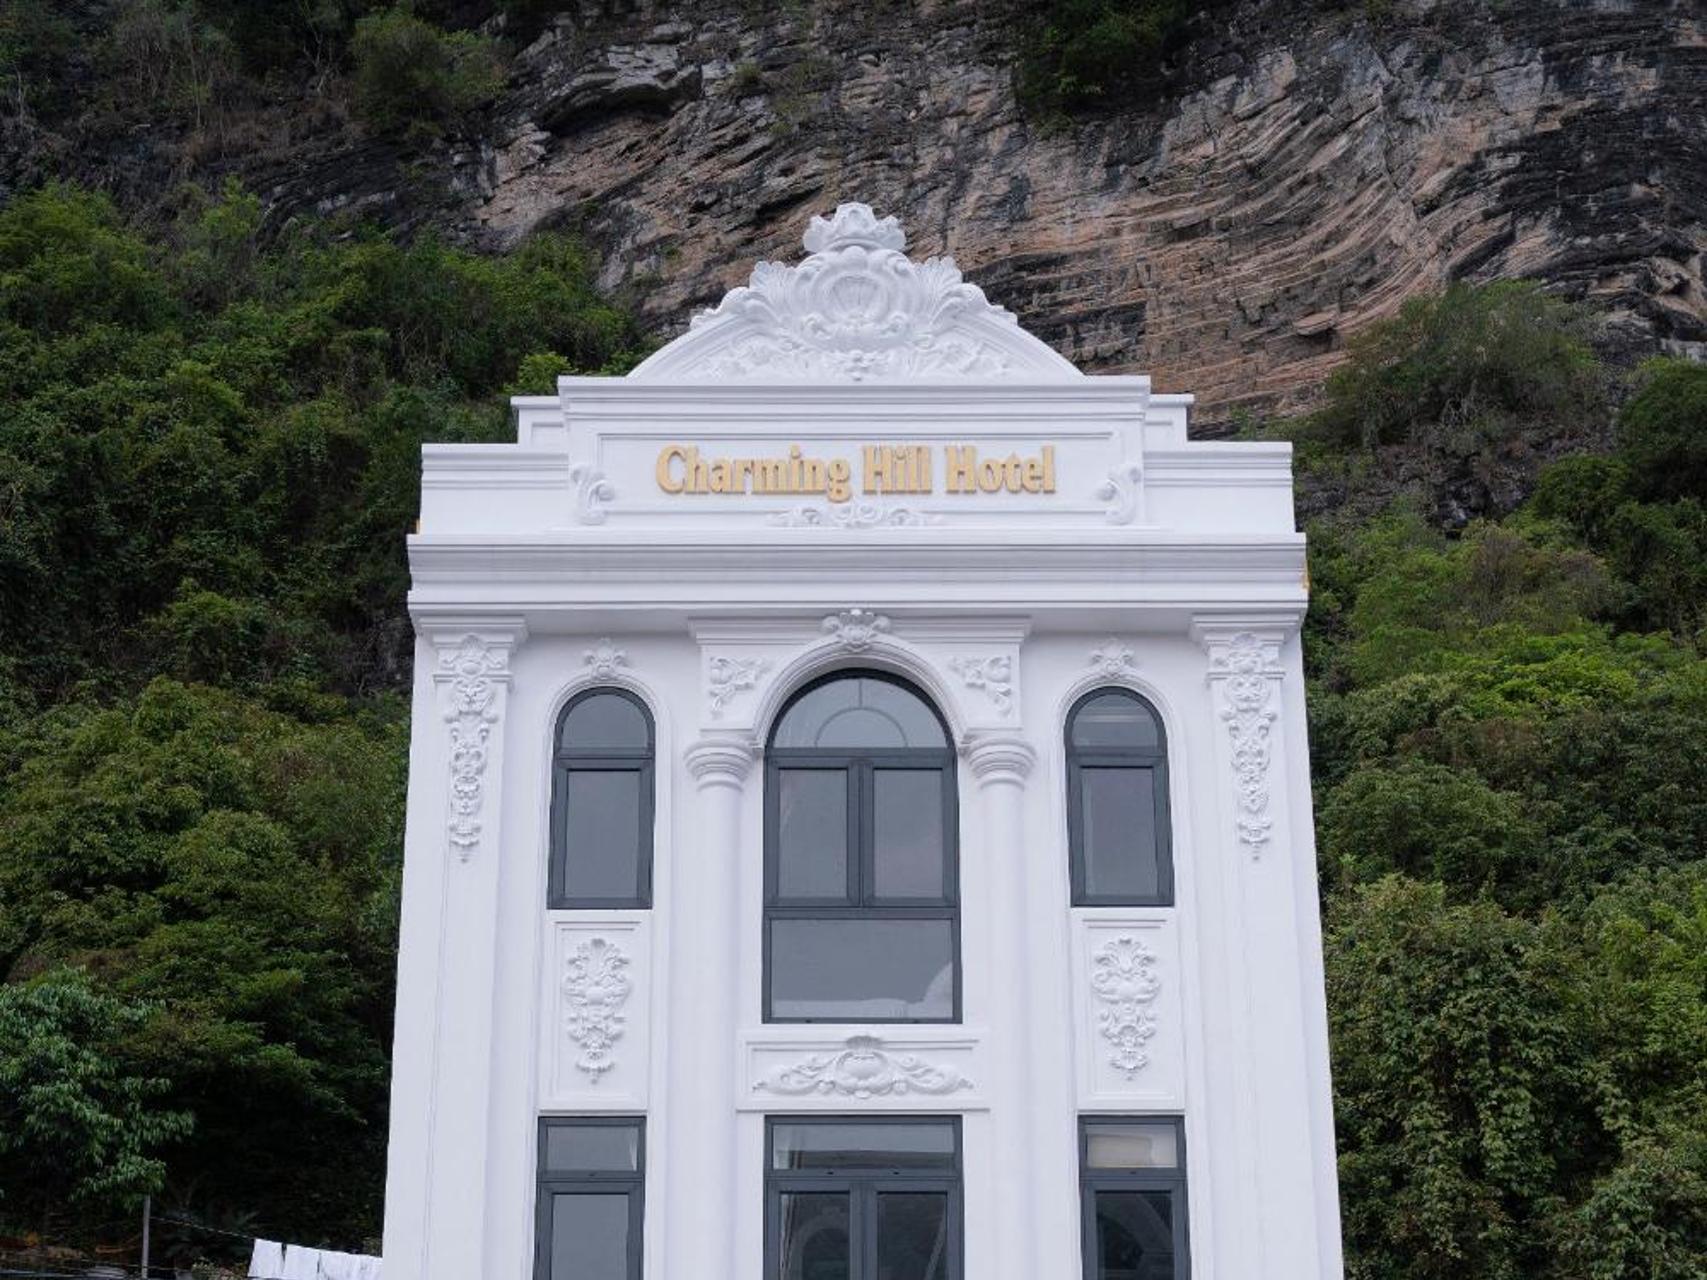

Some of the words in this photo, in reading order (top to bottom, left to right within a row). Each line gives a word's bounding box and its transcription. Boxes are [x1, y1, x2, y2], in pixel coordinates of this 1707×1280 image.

[656, 444, 852, 502] Charming
[862, 444, 933, 495] Hill
[945, 444, 1056, 495] Hotel
